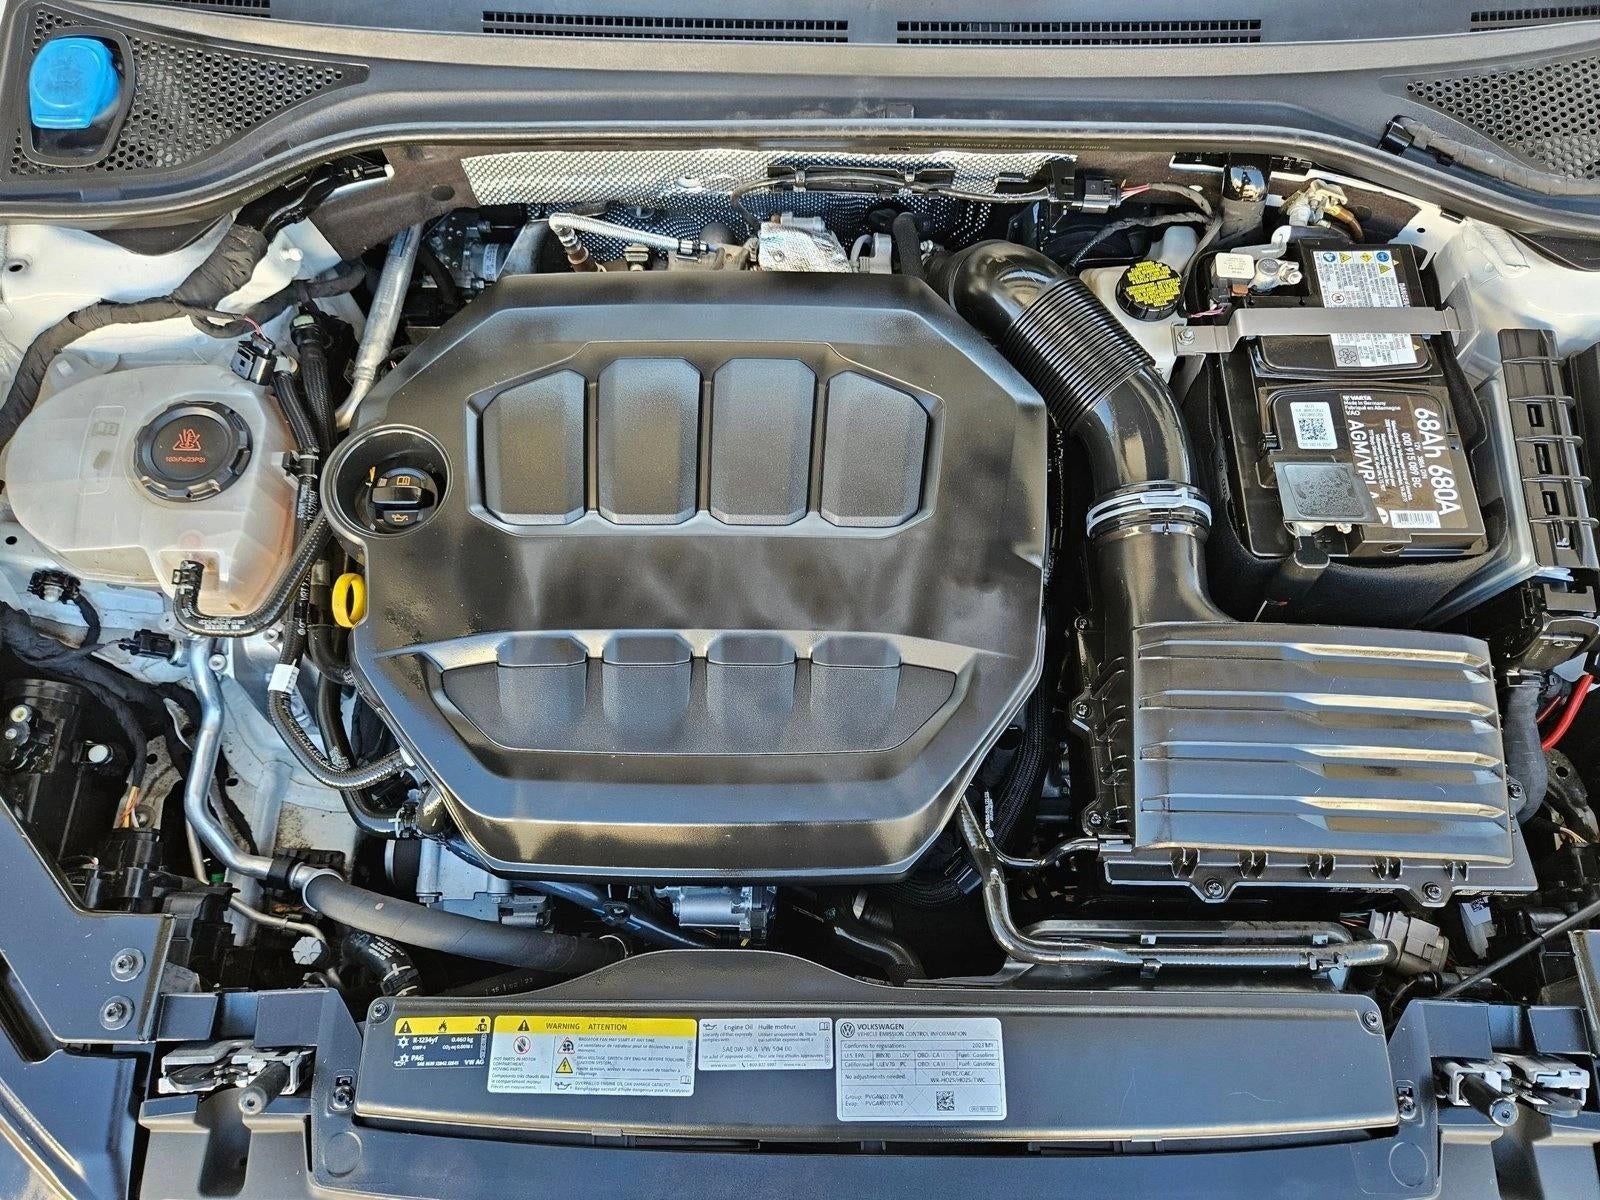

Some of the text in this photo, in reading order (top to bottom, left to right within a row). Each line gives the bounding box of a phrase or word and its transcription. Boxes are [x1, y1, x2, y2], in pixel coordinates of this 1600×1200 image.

[1401, 432, 1422, 488] 000 915 089 BC
[1414, 408, 1461, 516] 68Ah 680A
[588, 1023, 627, 1031] ATTENTION
